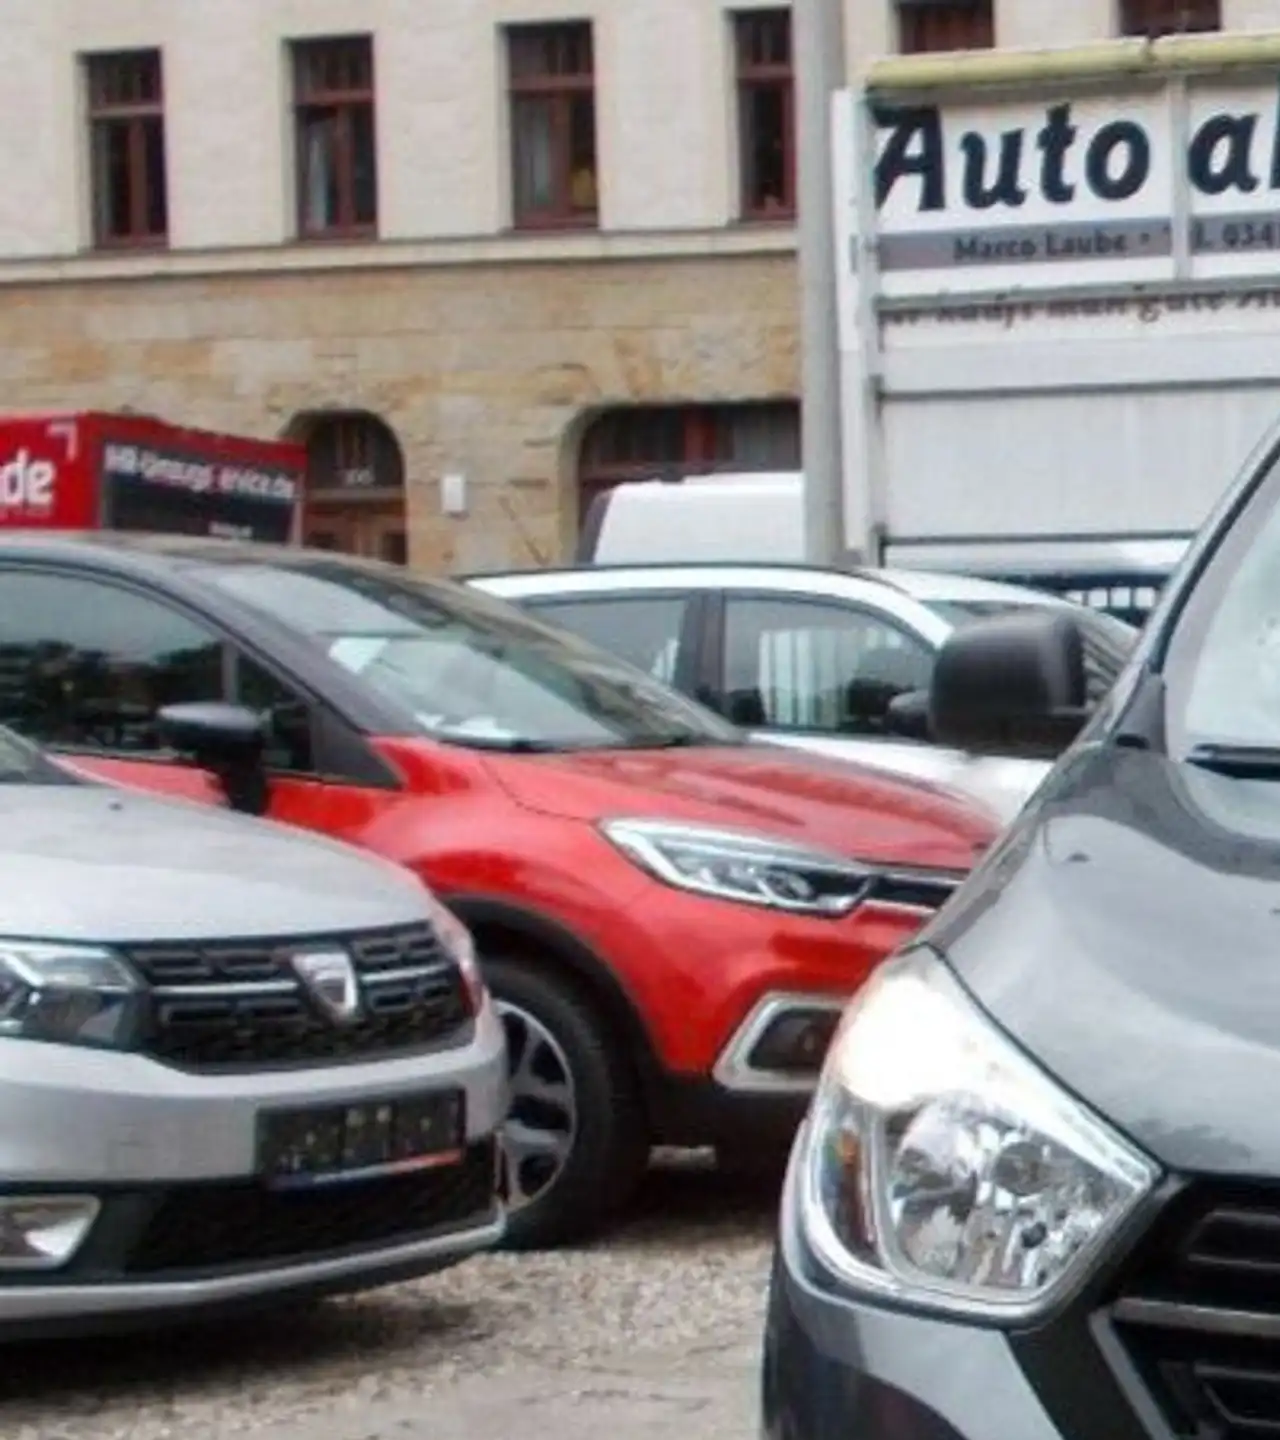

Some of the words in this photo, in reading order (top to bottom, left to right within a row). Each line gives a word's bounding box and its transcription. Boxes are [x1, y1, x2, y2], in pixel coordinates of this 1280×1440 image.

[871, 102, 1151, 211] Auto
[954, 236, 1037, 260] Marco
[1046, 227, 1127, 256] Laube
